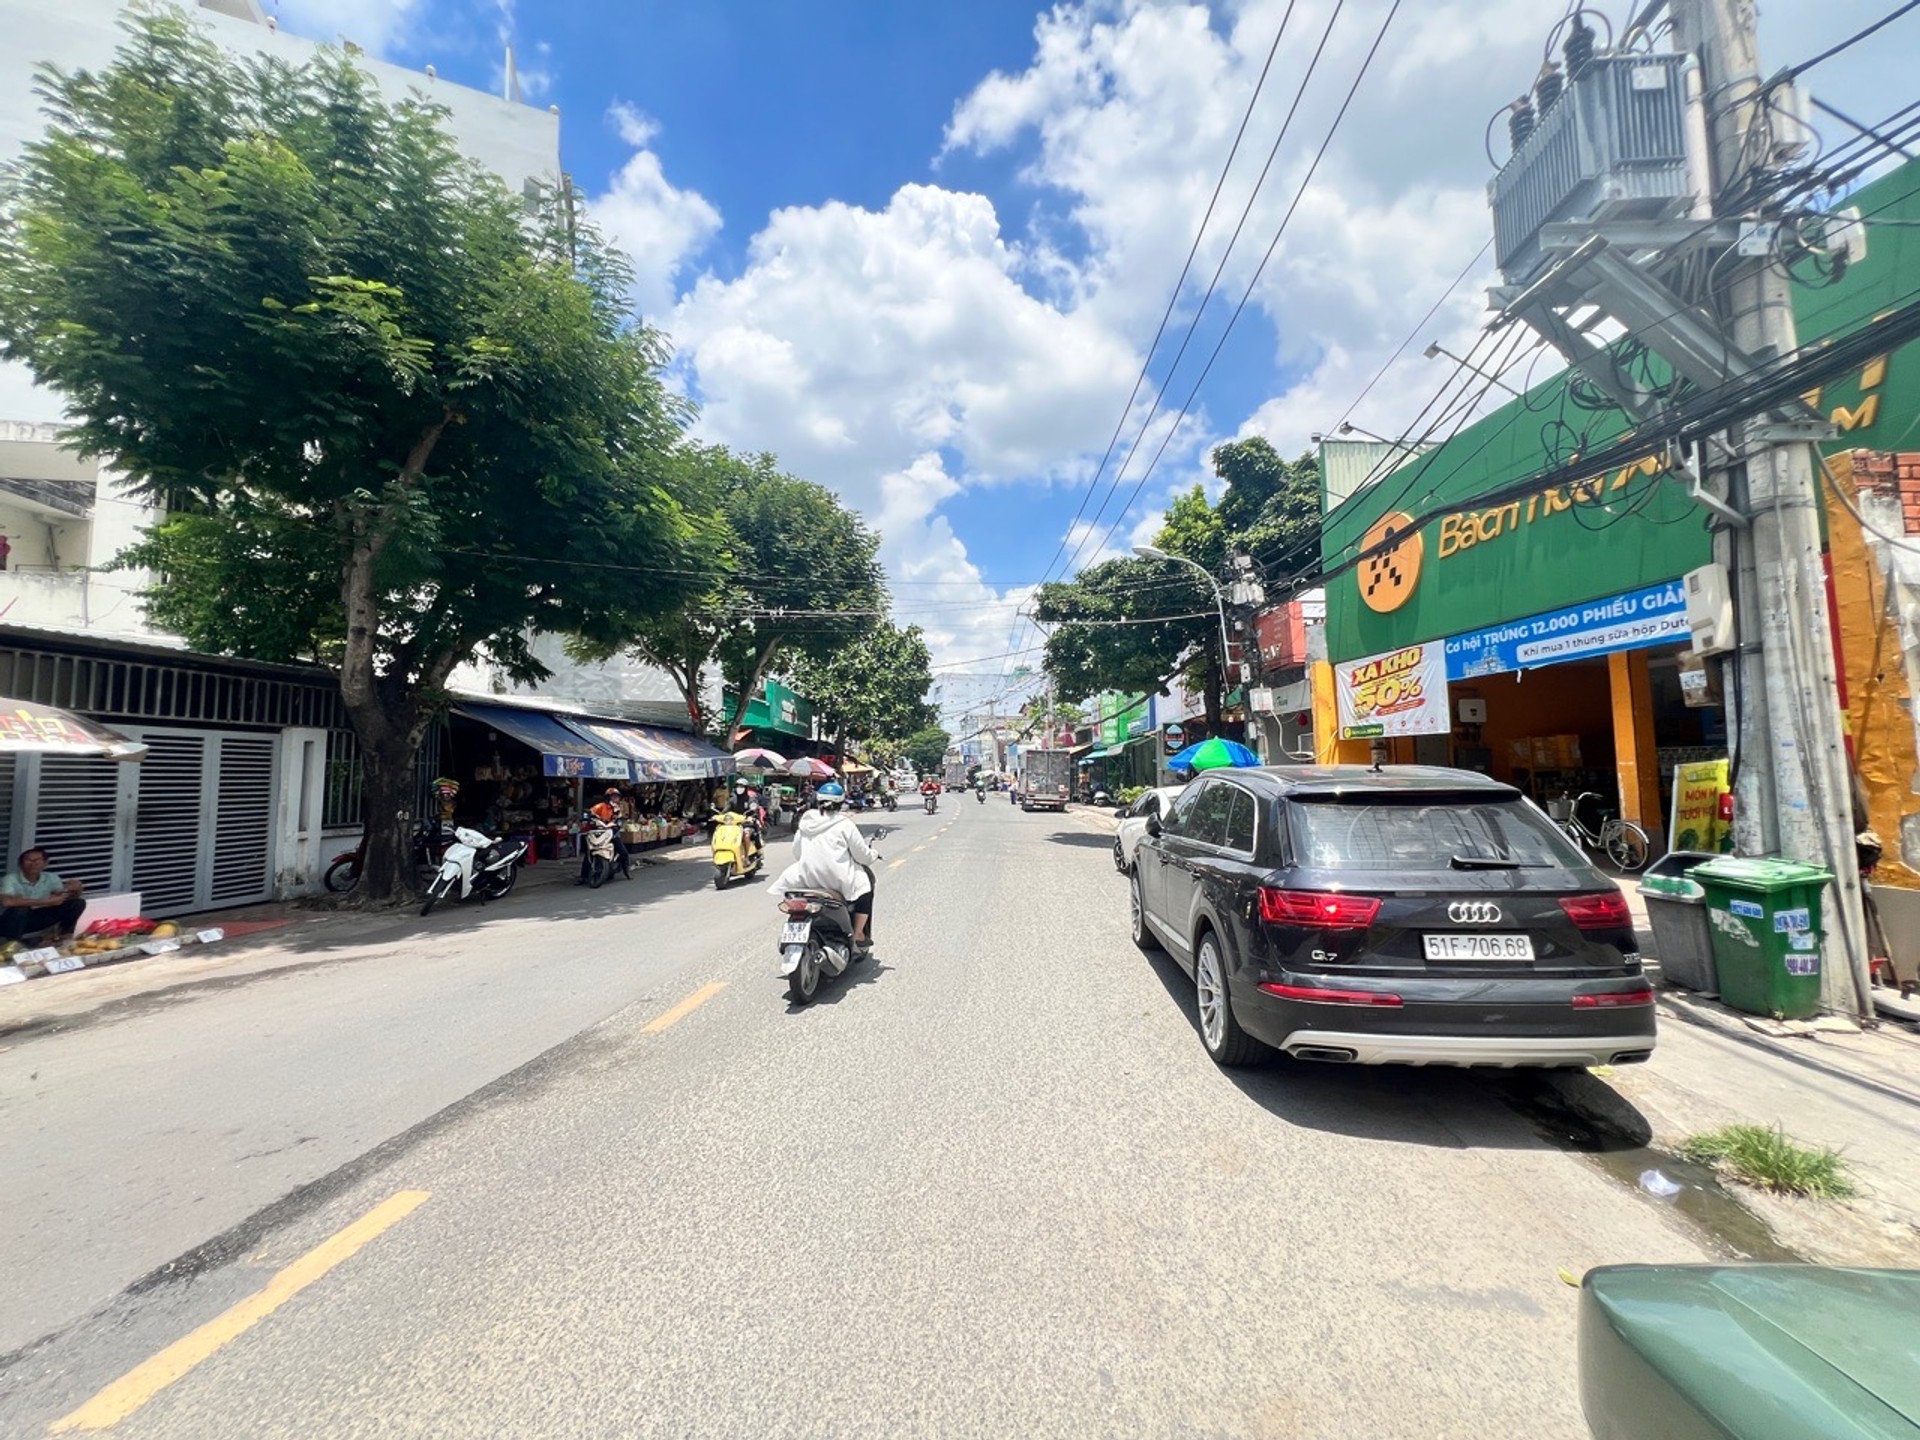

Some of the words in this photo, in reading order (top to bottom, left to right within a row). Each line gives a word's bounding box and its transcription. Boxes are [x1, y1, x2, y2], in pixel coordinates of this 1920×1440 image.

[1462, 634, 1482, 652] hội
[1483, 626, 1529, 646] TRÚNG
[1531, 613, 1579, 635] 12.000
[1582, 594, 1638, 624] PHIẾU
[1381, 648, 1421, 675] KHO
[1523, 645, 1539, 657] Khi
[1541, 643, 1563, 653] mua
[1565, 640, 1571, 650] 1
[1355, 676, 1423, 710] 50%
[1428, 937, 1528, 957] 51F-706.68
